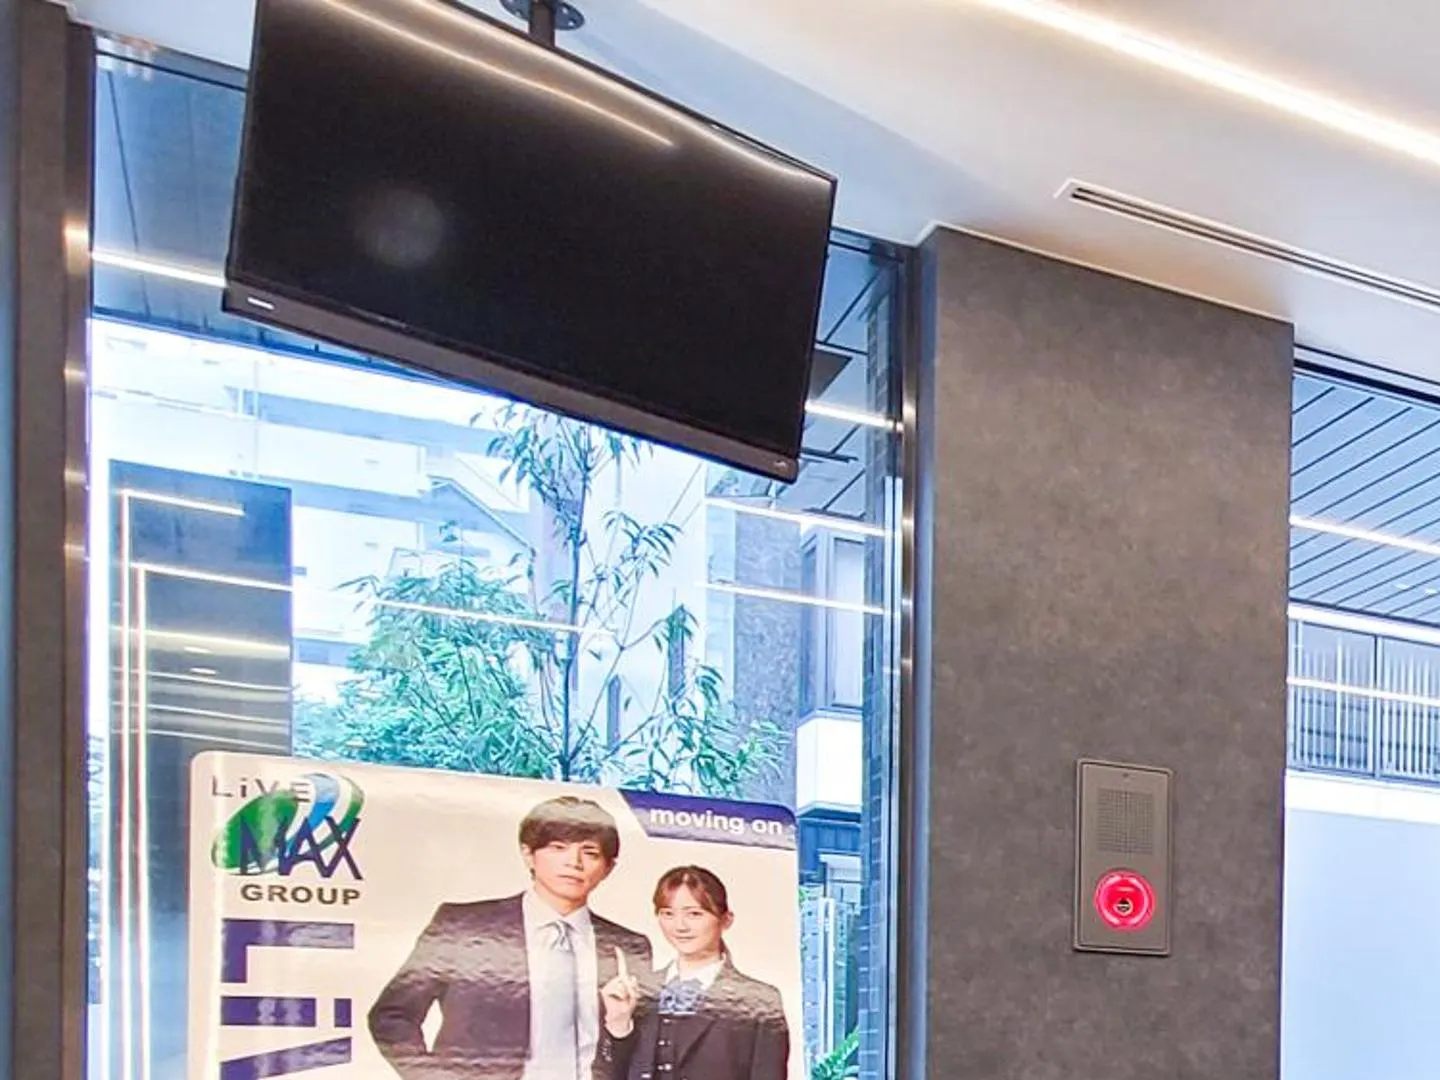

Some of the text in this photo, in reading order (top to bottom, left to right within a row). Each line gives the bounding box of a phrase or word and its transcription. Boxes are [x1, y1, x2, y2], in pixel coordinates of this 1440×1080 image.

[211, 775, 311, 803] LiVE
[650, 808, 783, 835] moving on
[239, 815, 364, 881] MAX
[240, 884, 361, 906] GROUP
